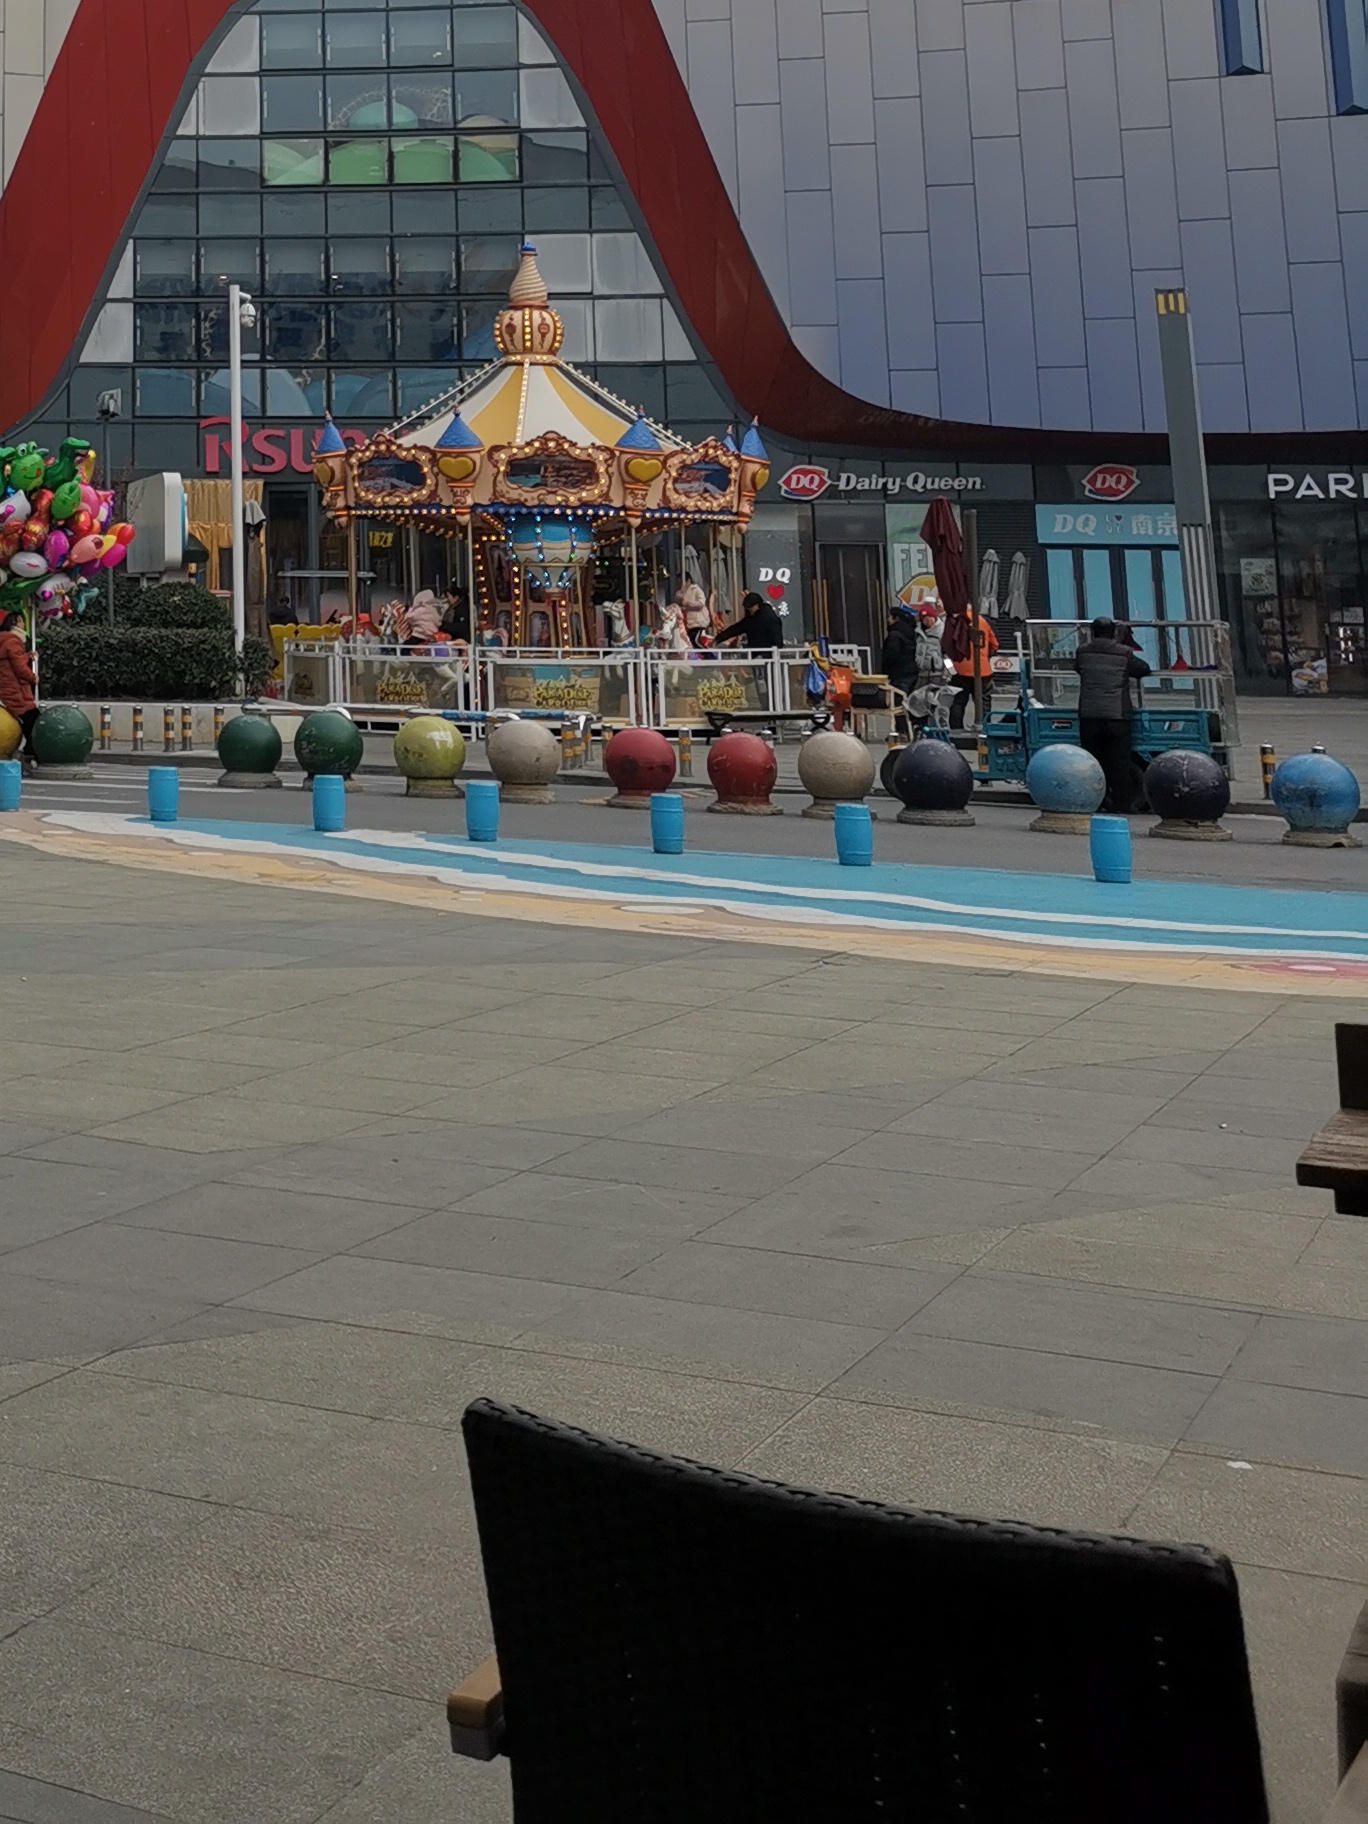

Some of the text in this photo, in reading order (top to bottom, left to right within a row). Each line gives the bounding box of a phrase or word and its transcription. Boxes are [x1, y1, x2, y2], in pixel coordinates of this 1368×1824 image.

[790, 472, 981, 494] DQ Dairy Queen
[1095, 473, 1128, 491] DQ
[1053, 513, 1097, 536] DQ
[759, 568, 791, 584] DQ
